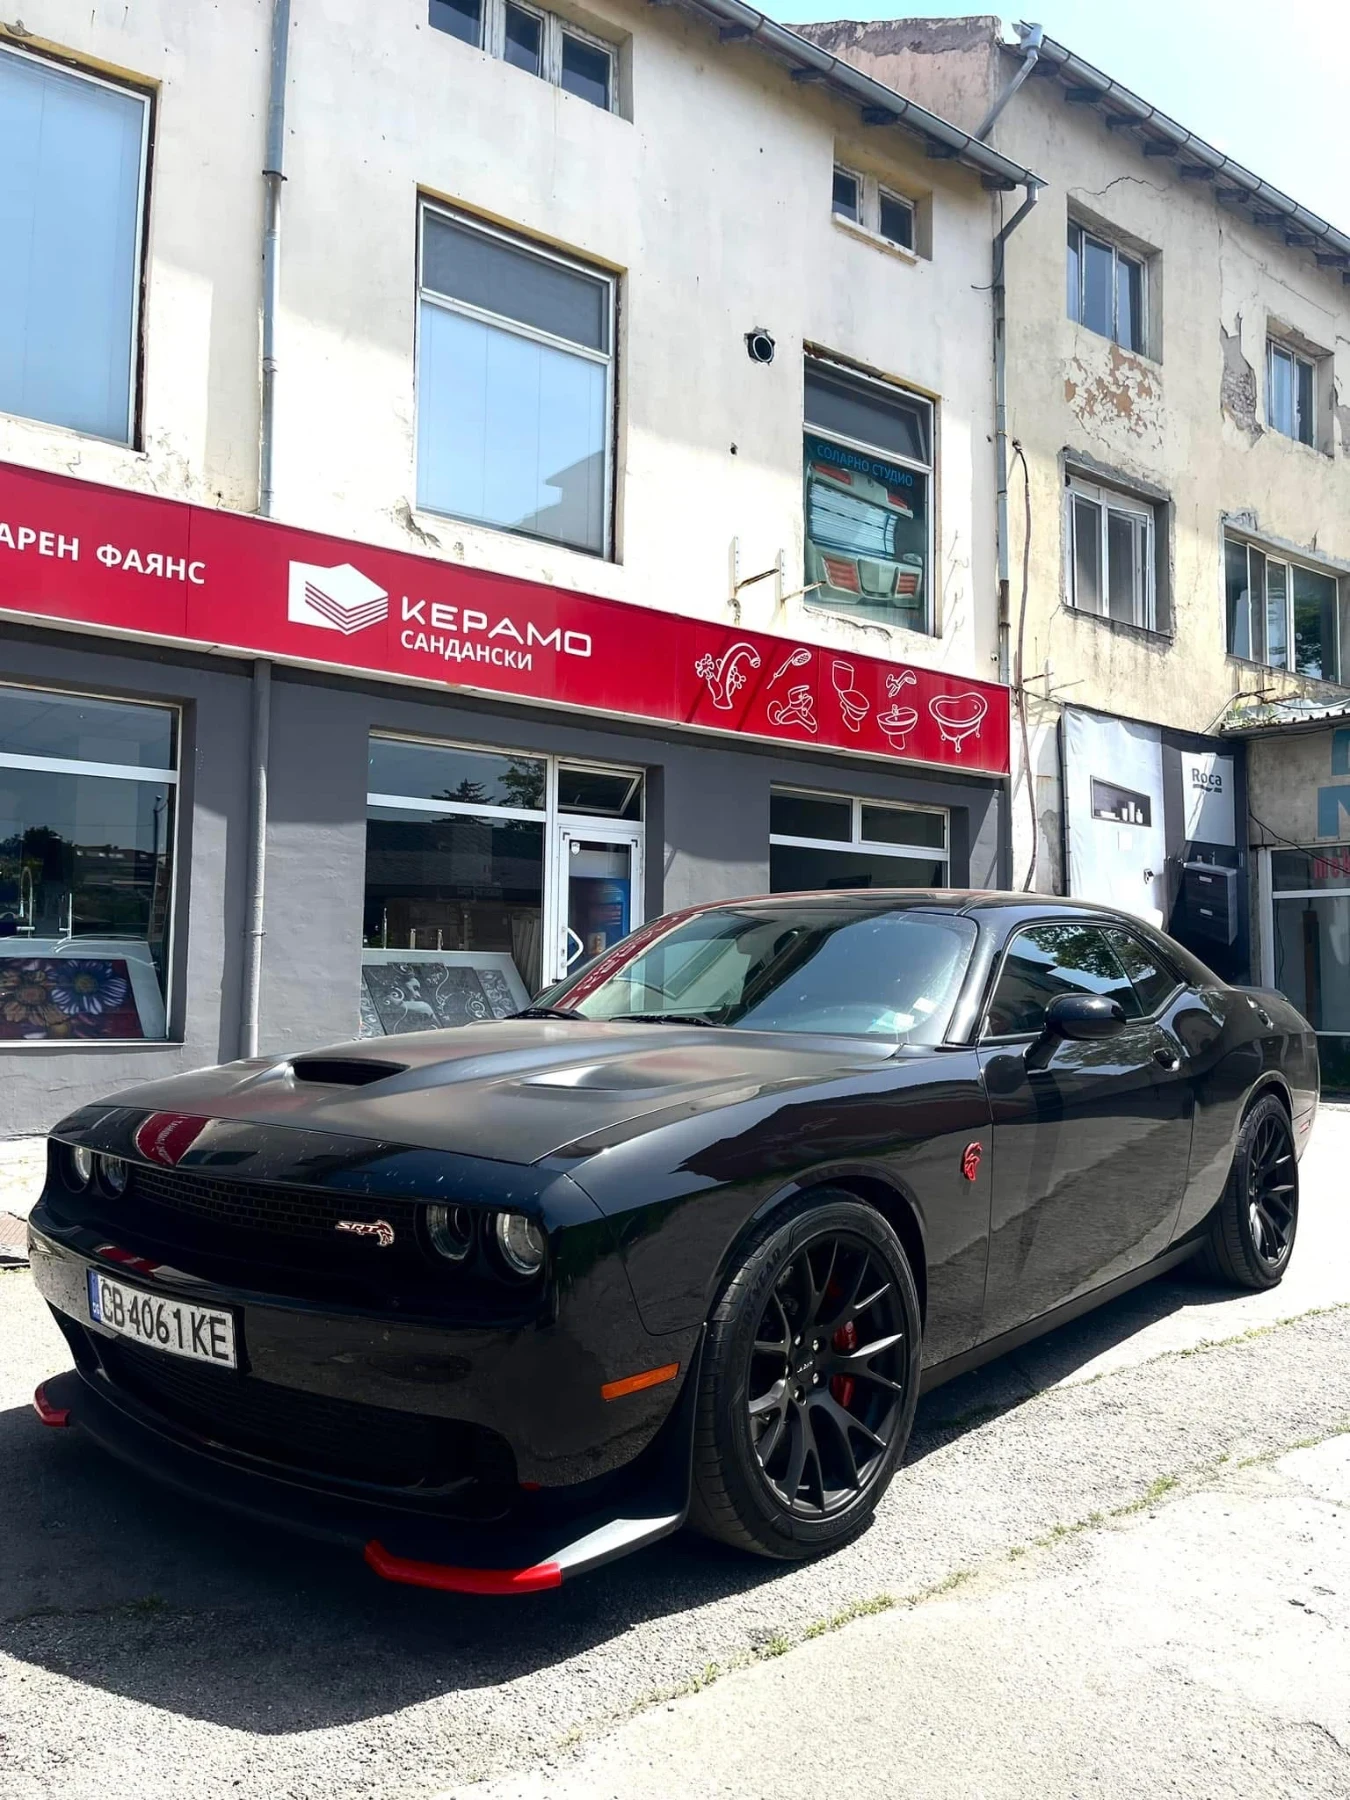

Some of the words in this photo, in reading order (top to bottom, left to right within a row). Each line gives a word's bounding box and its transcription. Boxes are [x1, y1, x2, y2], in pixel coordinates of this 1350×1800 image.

[817, 445, 869, 472] СОЛАРНО
[872, 464, 913, 487] СТУДИО
[96, 543, 206, 584] ФАЯНС
[402, 596, 592, 658] КЕРАМО
[400, 629, 532, 672] САНДАНСКИ
[1191, 768, 1222, 786] Roca
[336, 1222, 379, 1235] SRT
